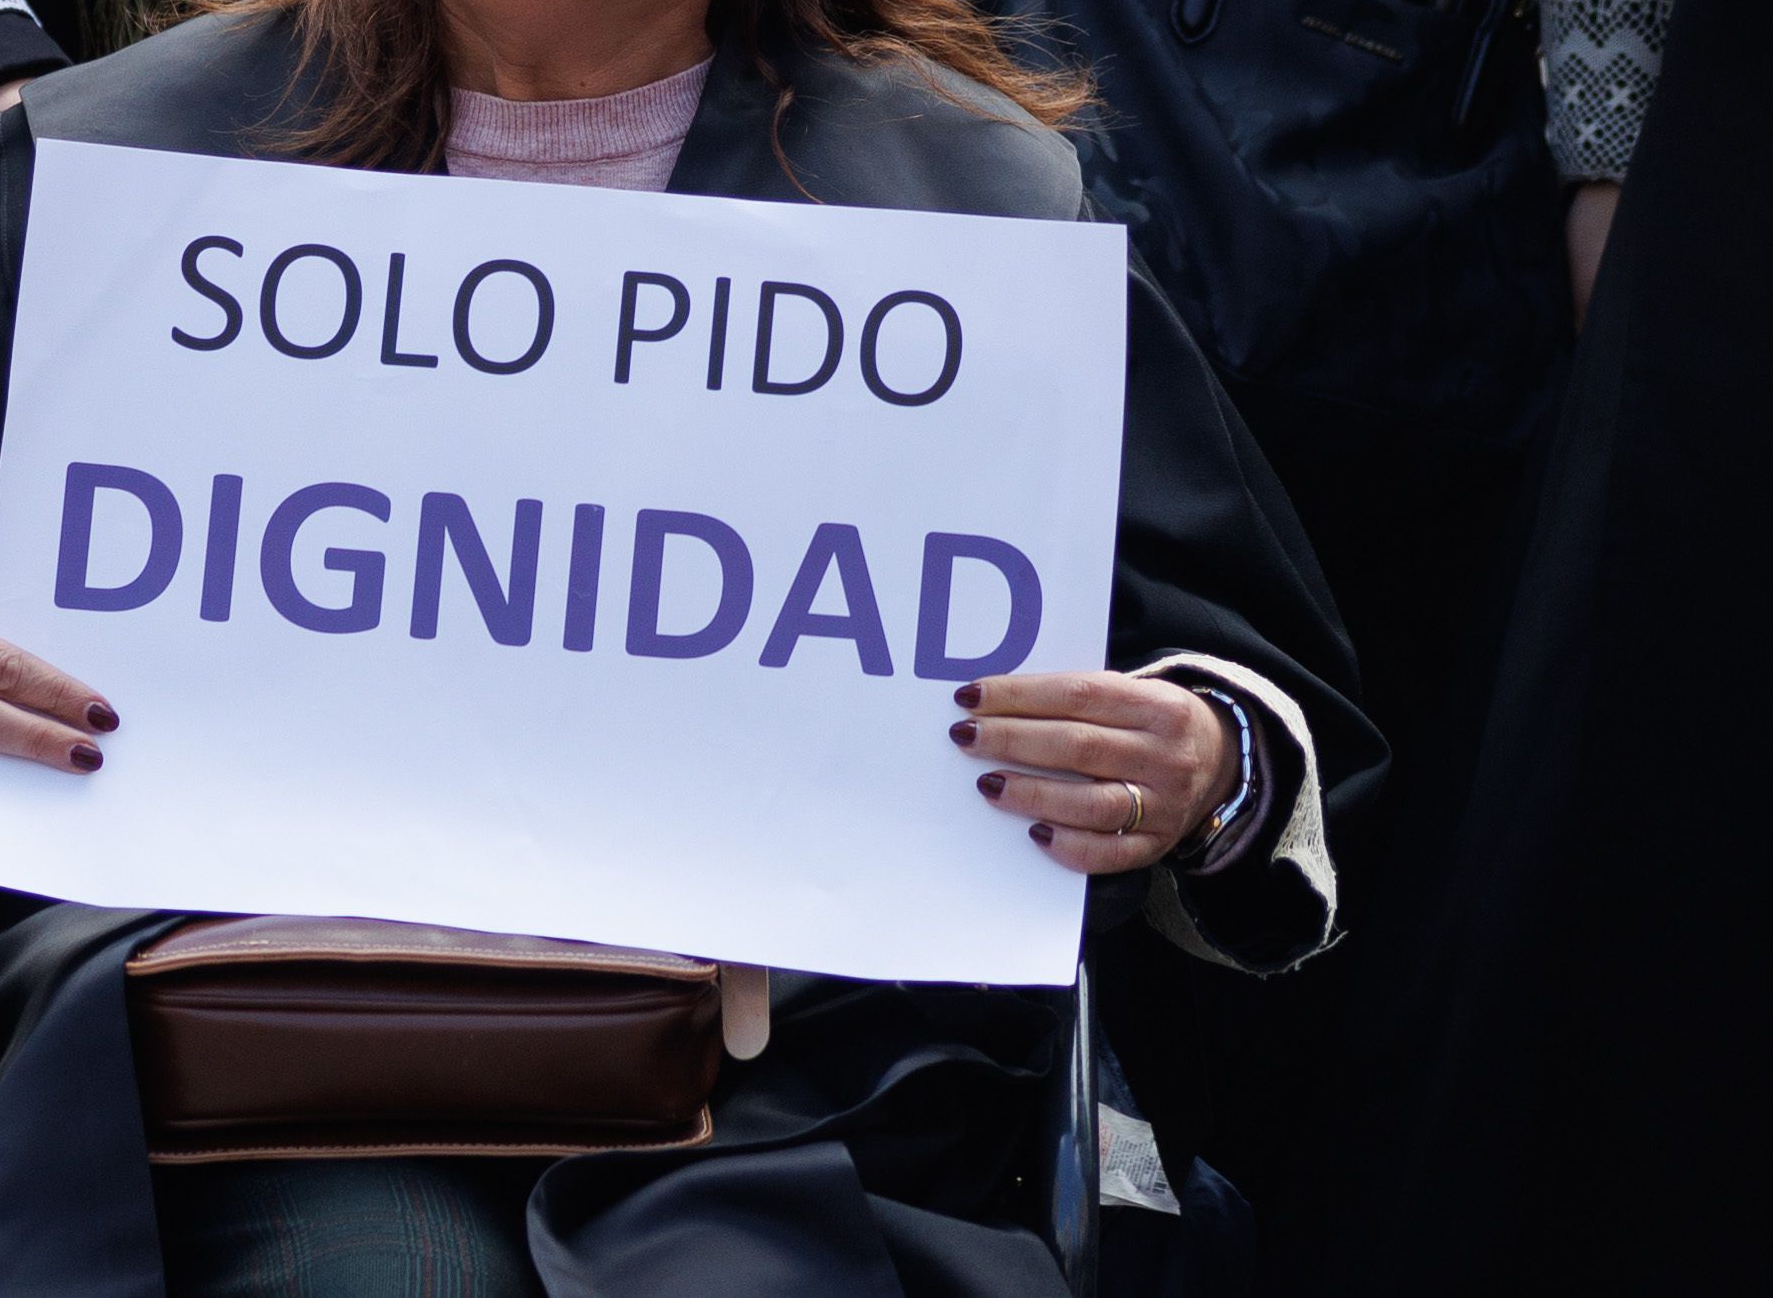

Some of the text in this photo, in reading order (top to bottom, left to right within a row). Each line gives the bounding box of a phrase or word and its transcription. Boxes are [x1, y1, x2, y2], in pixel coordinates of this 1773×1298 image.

[170, 234, 964, 407] SOLO PIDO
[54, 460, 1044, 683] DIGNIDAD
